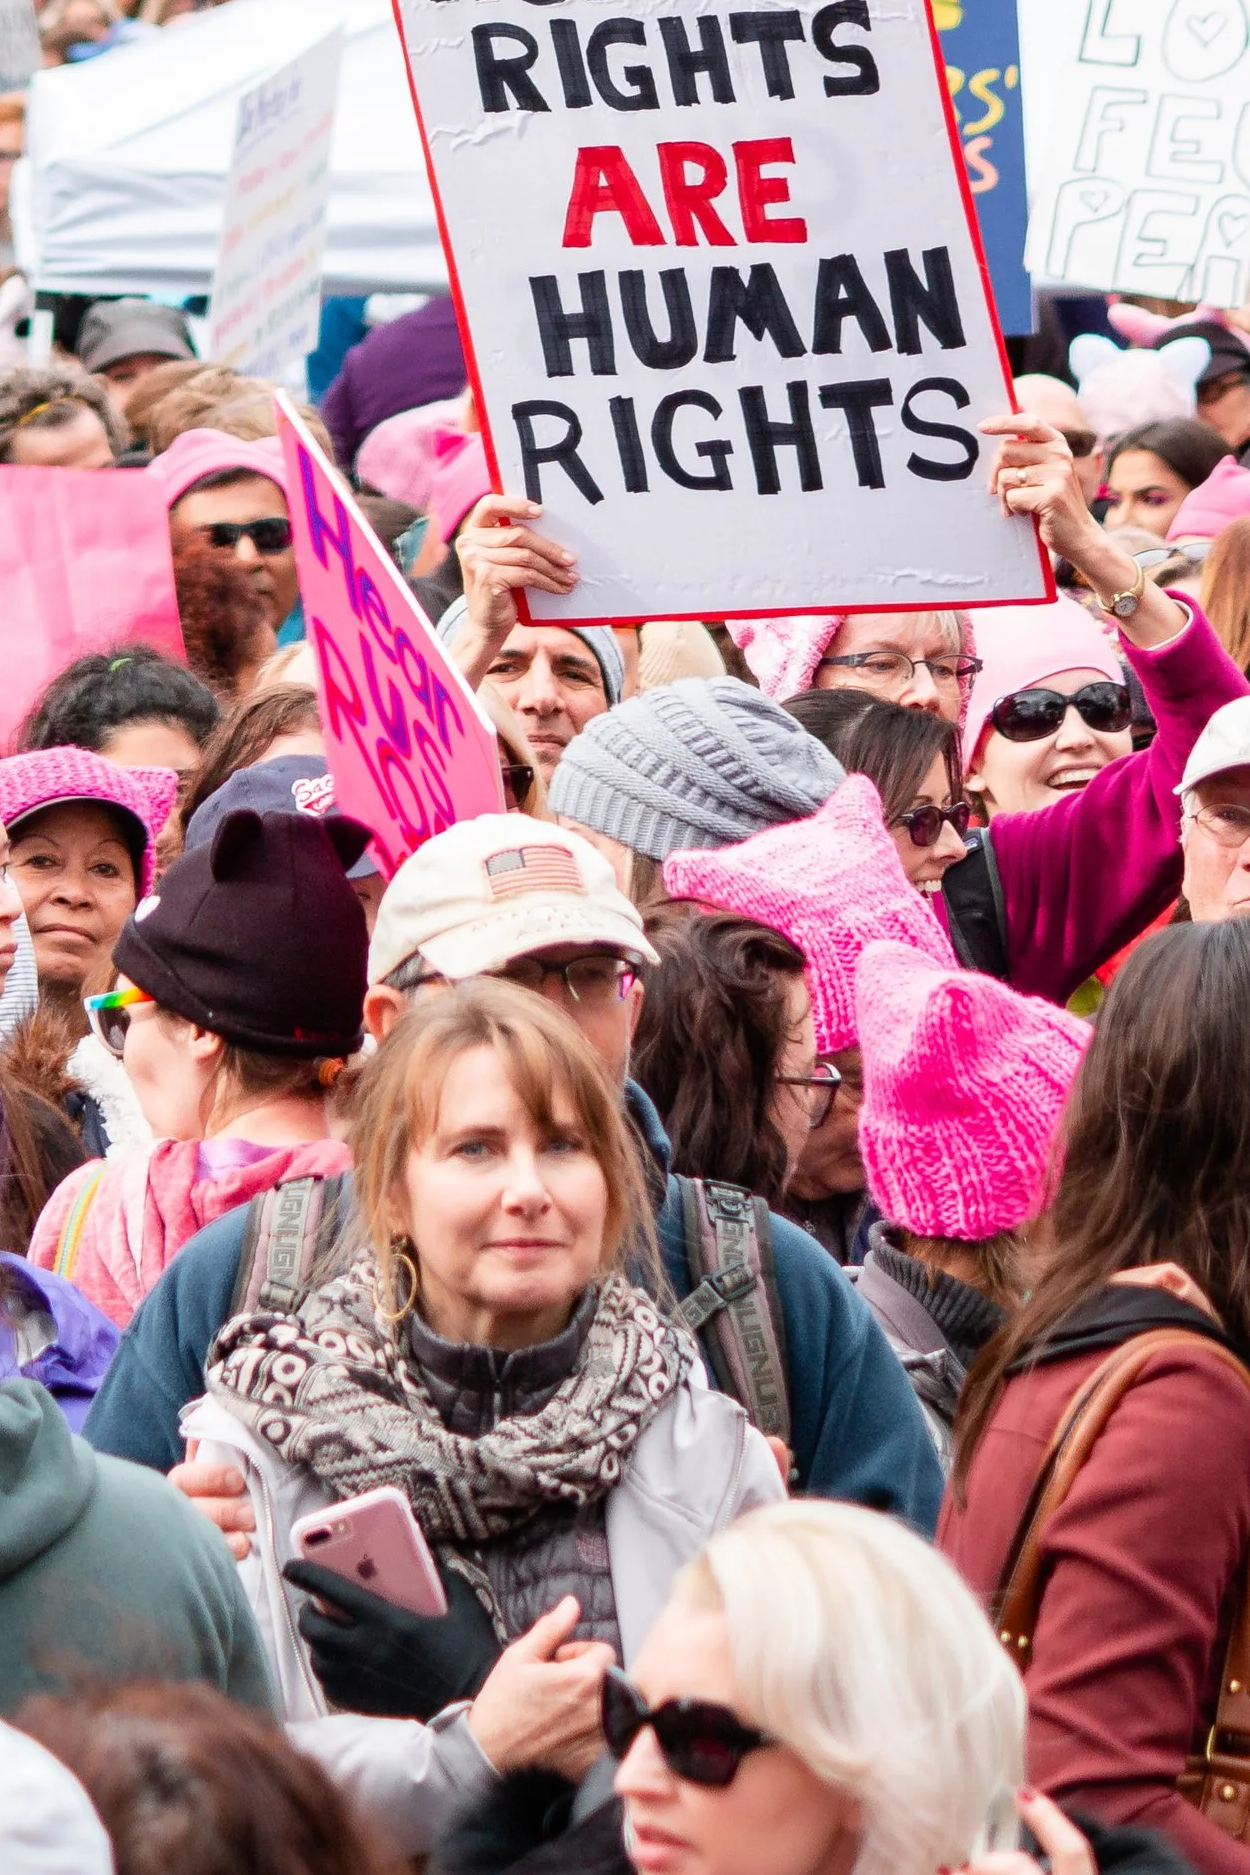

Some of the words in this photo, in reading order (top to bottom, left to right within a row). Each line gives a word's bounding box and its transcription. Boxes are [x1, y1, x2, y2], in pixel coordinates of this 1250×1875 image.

[471, 0, 881, 113] RIGHTS
[562, 137, 809, 248] ARE
[529, 246, 967, 377] HUMAN
[511, 377, 980, 505] RIGHTS
[297, 441, 465, 758] Hear
[312, 615, 448, 854] Ro
